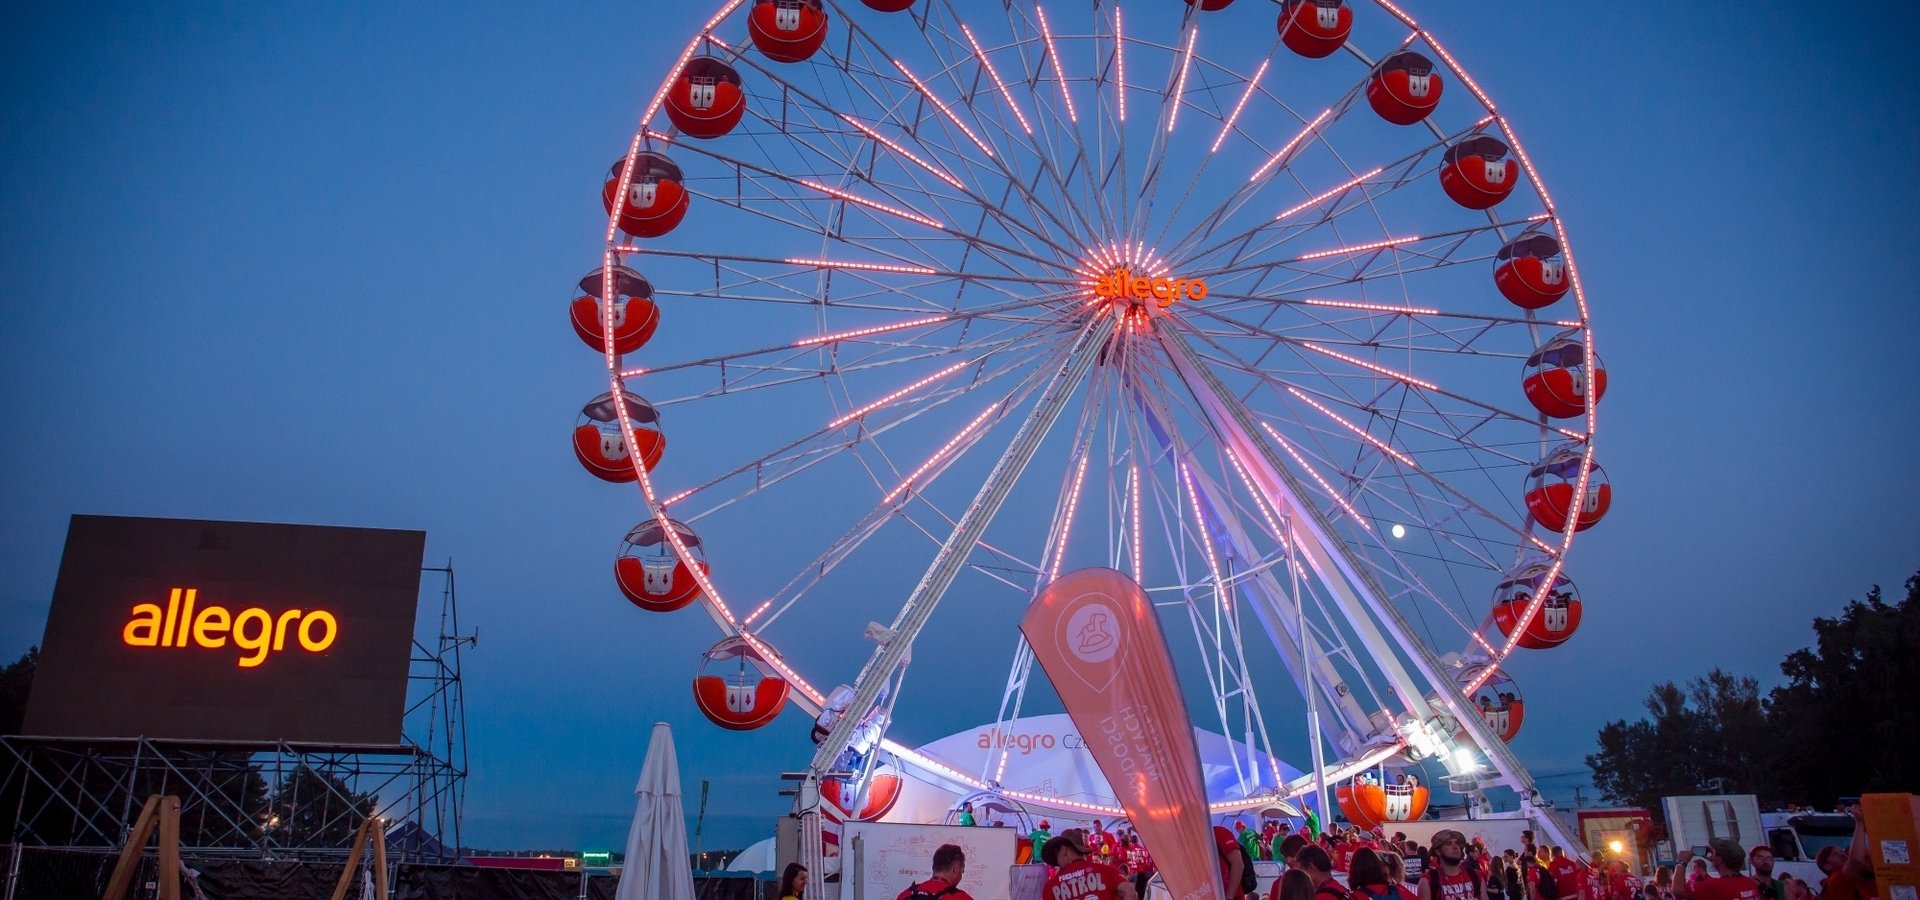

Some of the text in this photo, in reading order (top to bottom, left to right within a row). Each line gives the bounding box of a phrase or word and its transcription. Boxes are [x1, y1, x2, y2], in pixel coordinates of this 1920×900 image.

[1094, 266, 1208, 308] allegro
[123, 588, 337, 667] allegro
[977, 728, 1055, 755] allegro
[1052, 872, 1106, 900] PATROL
